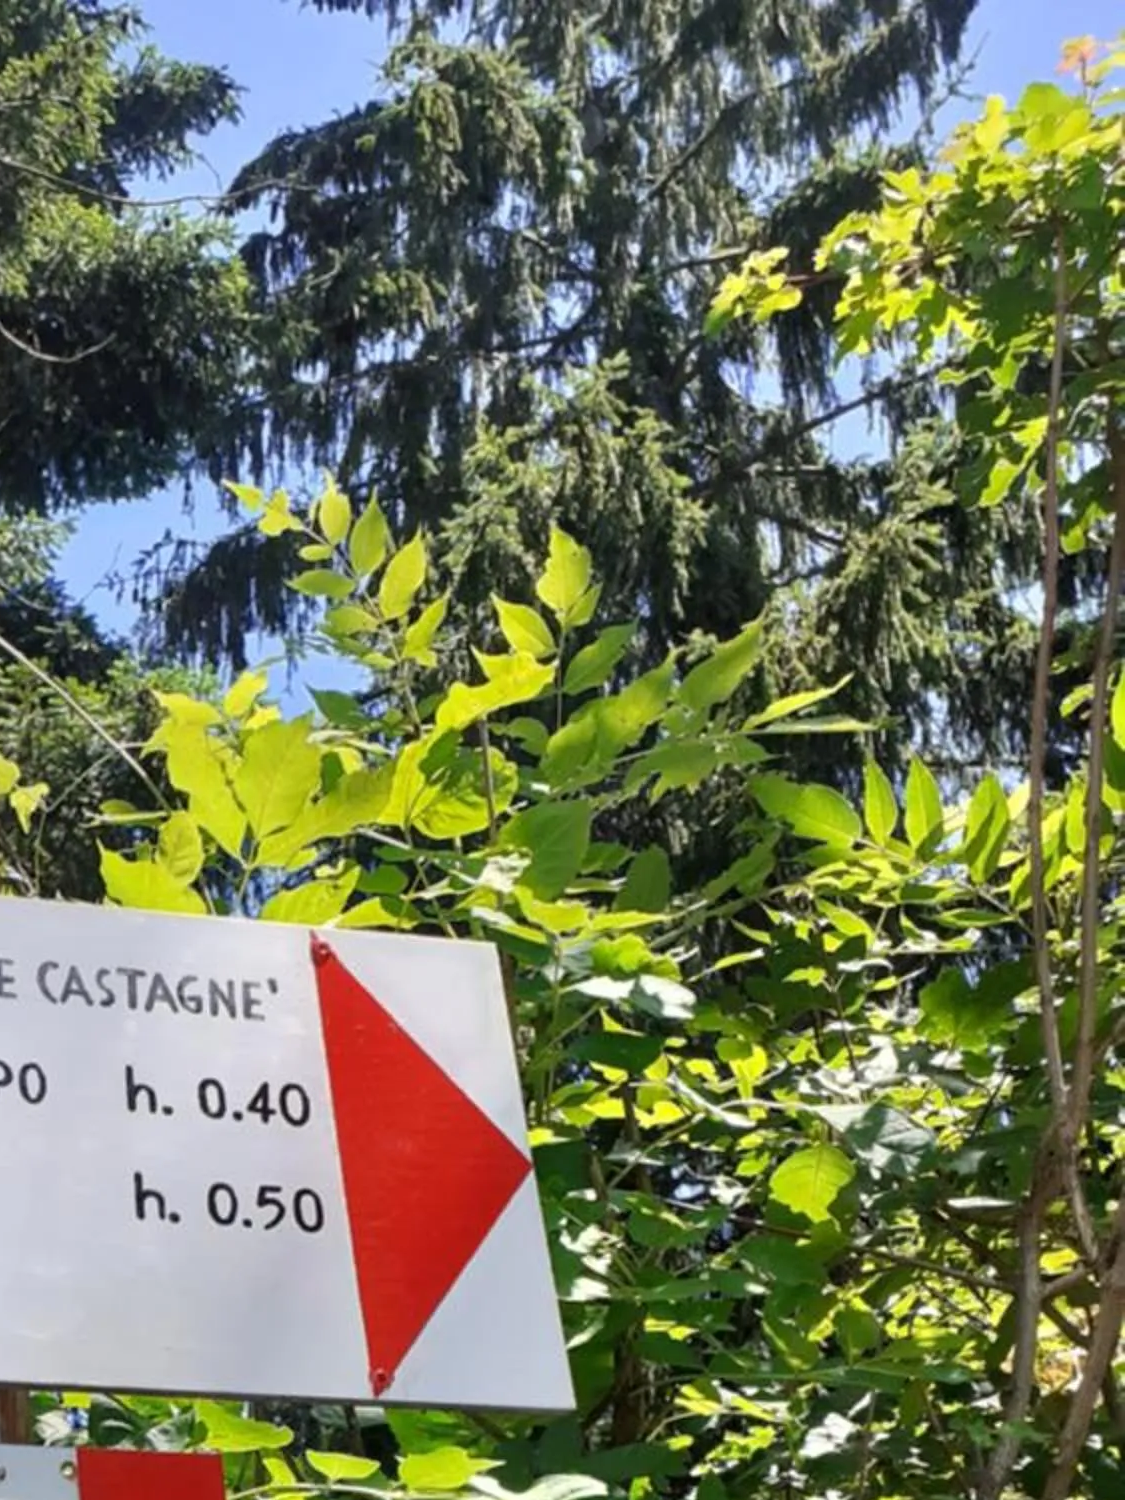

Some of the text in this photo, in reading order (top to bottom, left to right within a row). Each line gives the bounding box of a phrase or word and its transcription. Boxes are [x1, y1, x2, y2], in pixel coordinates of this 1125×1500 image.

[125, 1065, 174, 1117] h.
[197, 1078, 312, 1127] 0.40
[133, 1171, 181, 1225] h.
[206, 1181, 325, 1233] 0.50
